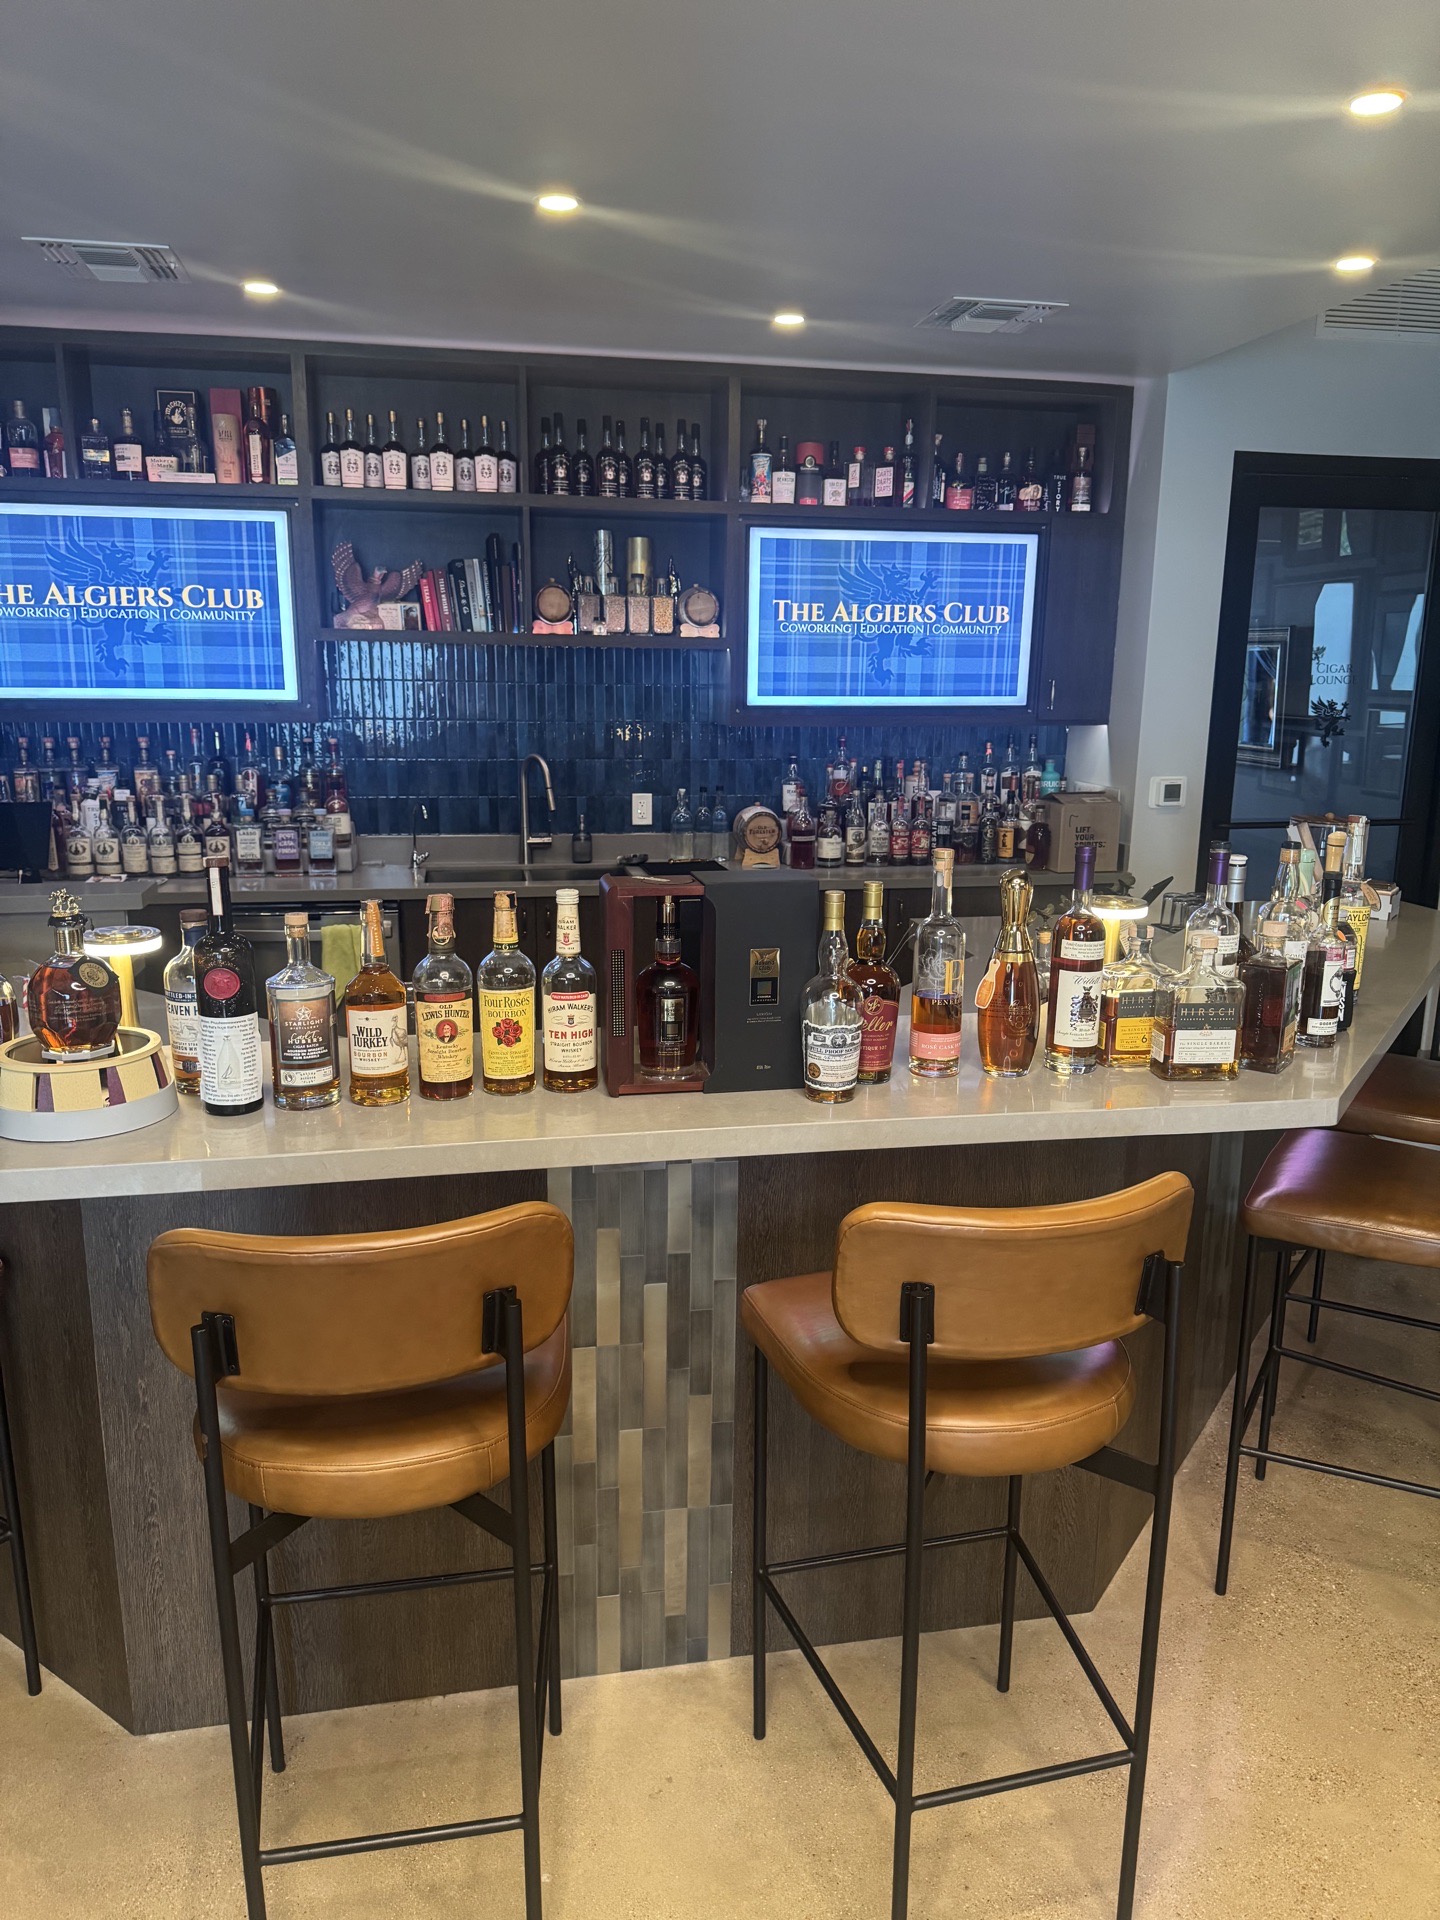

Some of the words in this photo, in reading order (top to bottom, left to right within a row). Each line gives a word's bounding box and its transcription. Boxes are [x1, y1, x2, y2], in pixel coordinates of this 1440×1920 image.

[0, 584, 35, 604] HE
[42, 582, 174, 608] ALGIERS
[182, 584, 264, 609] CLUB
[0, 606, 70, 618] WORKING
[80, 607, 160, 620] EDUCATION
[170, 608, 256, 621] COMMUNITY
[773, 599, 824, 622] THE
[830, 600, 936, 623] ALGIERS
[944, 602, 1010, 624] CLUB
[780, 622, 852, 634] COWORKING
[860, 623, 924, 634] EDUCATION
[932, 624, 1002, 635] COMMUNITY
[1317, 662, 1353, 673] CIGAR
[944, 960, 964, 995] P
[484, 995, 503, 1008] Four
[504, 996, 530, 1008] Roses
[1122, 996, 1153, 1004] HIRS
[168, 1003, 190, 1016] EAVEN
[422, 1010, 443, 1021] LEWIS
[444, 1010, 470, 1019] HUNTER
[488, 1008, 527, 1018] BOURBON
[1181, 1008, 1235, 1016] HIRSCH
[285, 1018, 324, 1027] STARLIGHT
[862, 1016, 893, 1031] eller
[356, 1026, 382, 1038] WILD
[549, 1030, 567, 1039] TEN
[571, 1029, 593, 1039] HIGH
[352, 1034, 388, 1049] TURKEY
[1142, 1034, 1148, 1043] 6
